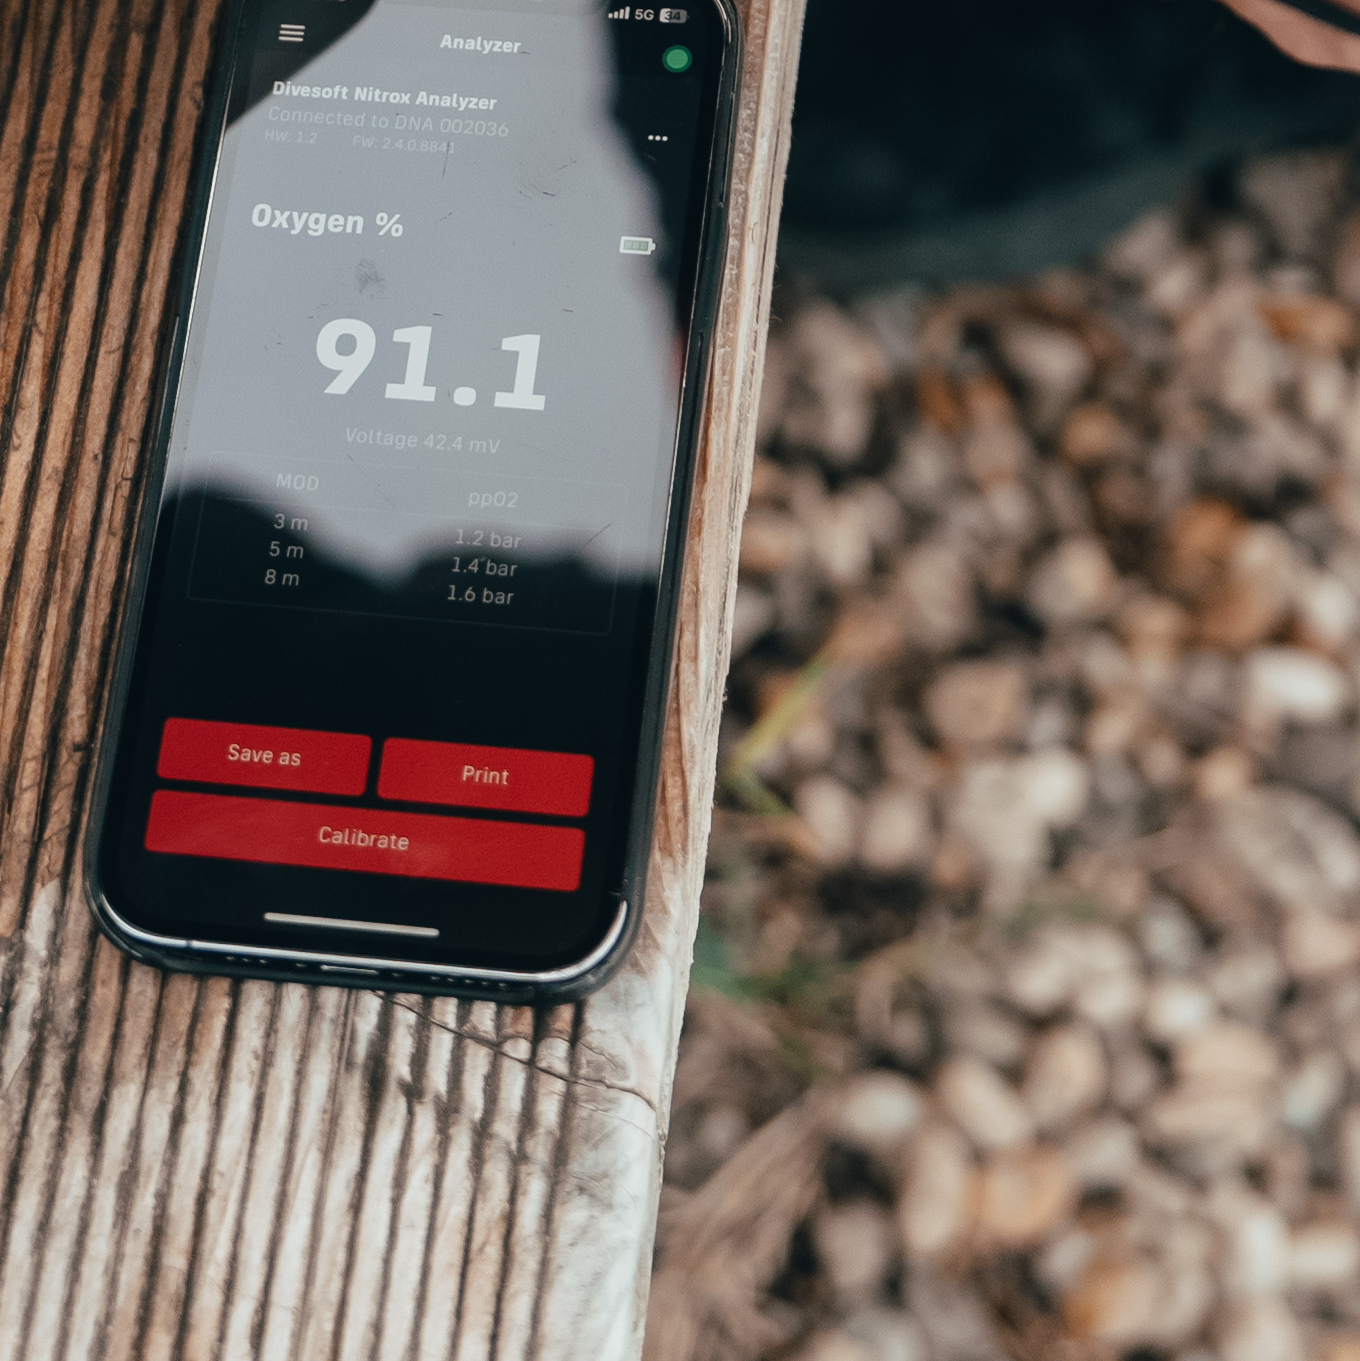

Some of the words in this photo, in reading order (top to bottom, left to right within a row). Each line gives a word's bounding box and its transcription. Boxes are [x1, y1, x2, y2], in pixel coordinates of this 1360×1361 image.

[635, 8, 654, 20] 5G
[439, 33, 522, 54] Analyzer
[272, 81, 348, 100] Divesoft
[354, 87, 410, 104] Nitrox
[415, 91, 497, 111] Analyzer
[268, 106, 366, 127] Connected
[372, 113, 389, 128] to
[395, 115, 434, 132] DNA
[440, 118, 509, 137] 002036
[265, 129, 291, 142] HW:
[298, 131, 318, 144] 1.2
[352, 135, 378, 148] FW:
[251, 203, 364, 237] Oxygen
[375, 211, 404, 238] %
[315, 318, 546, 410] 91.1
[345, 427, 418, 450] Voltage
[424, 434, 463, 450] 42.4
[469, 439, 501, 454] mV
[276, 473, 319, 490] MOD
[274, 513, 285, 530] 3
[290, 517, 309, 531] m
[455, 529, 484, 546] 1.2
[490, 531, 522, 549] bar
[269, 541, 280, 557] 5
[286, 545, 304, 559] m
[451, 557, 479, 574] 1.4
[486, 559, 518, 577] bar
[264, 569, 276, 585] 8
[282, 572, 300, 586] m
[447, 585, 476, 602] 1.6
[482, 587, 515, 605] bar
[227, 743, 274, 765] Save
[279, 750, 301, 767] as
[462, 765, 510, 786] Print
[317, 825, 410, 851] Calibrate
